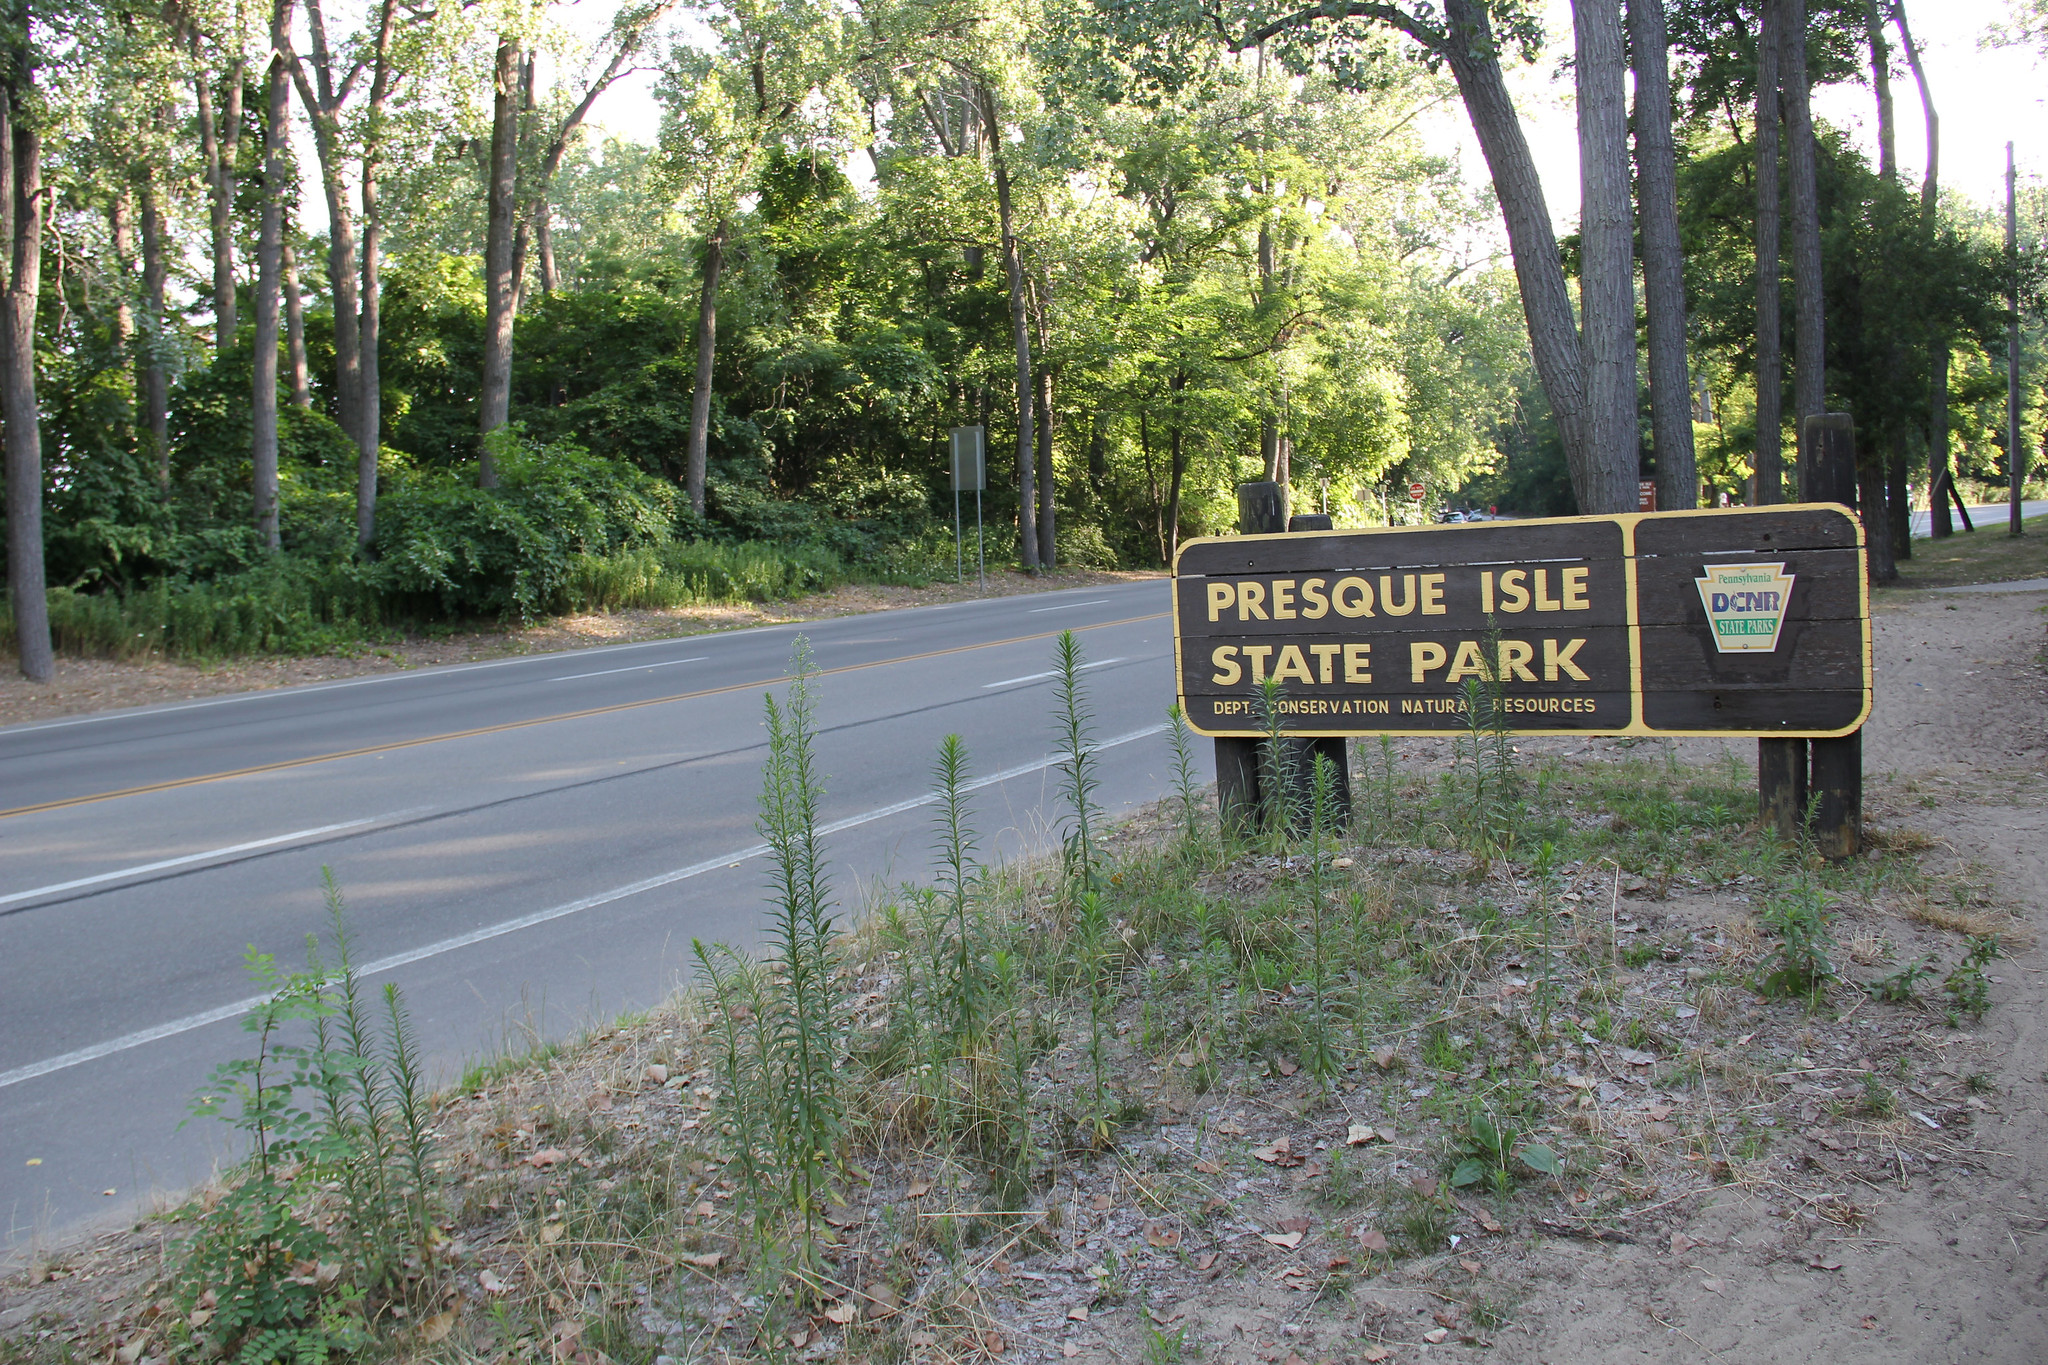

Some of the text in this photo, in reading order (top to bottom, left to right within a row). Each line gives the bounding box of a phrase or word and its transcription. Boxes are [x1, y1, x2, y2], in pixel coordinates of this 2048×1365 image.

[1718, 573, 1772, 586] Pennsylvania
[1206, 566, 1591, 622] PRESQUE ISLE
[1711, 591, 1780, 613] DCNR
[1720, 619, 1774, 635] STATE PARKS
[1211, 638, 1591, 686] STATE PARK
[1213, 701, 1256, 715] DEPT.
[1401, 698, 1478, 714] NATURA
